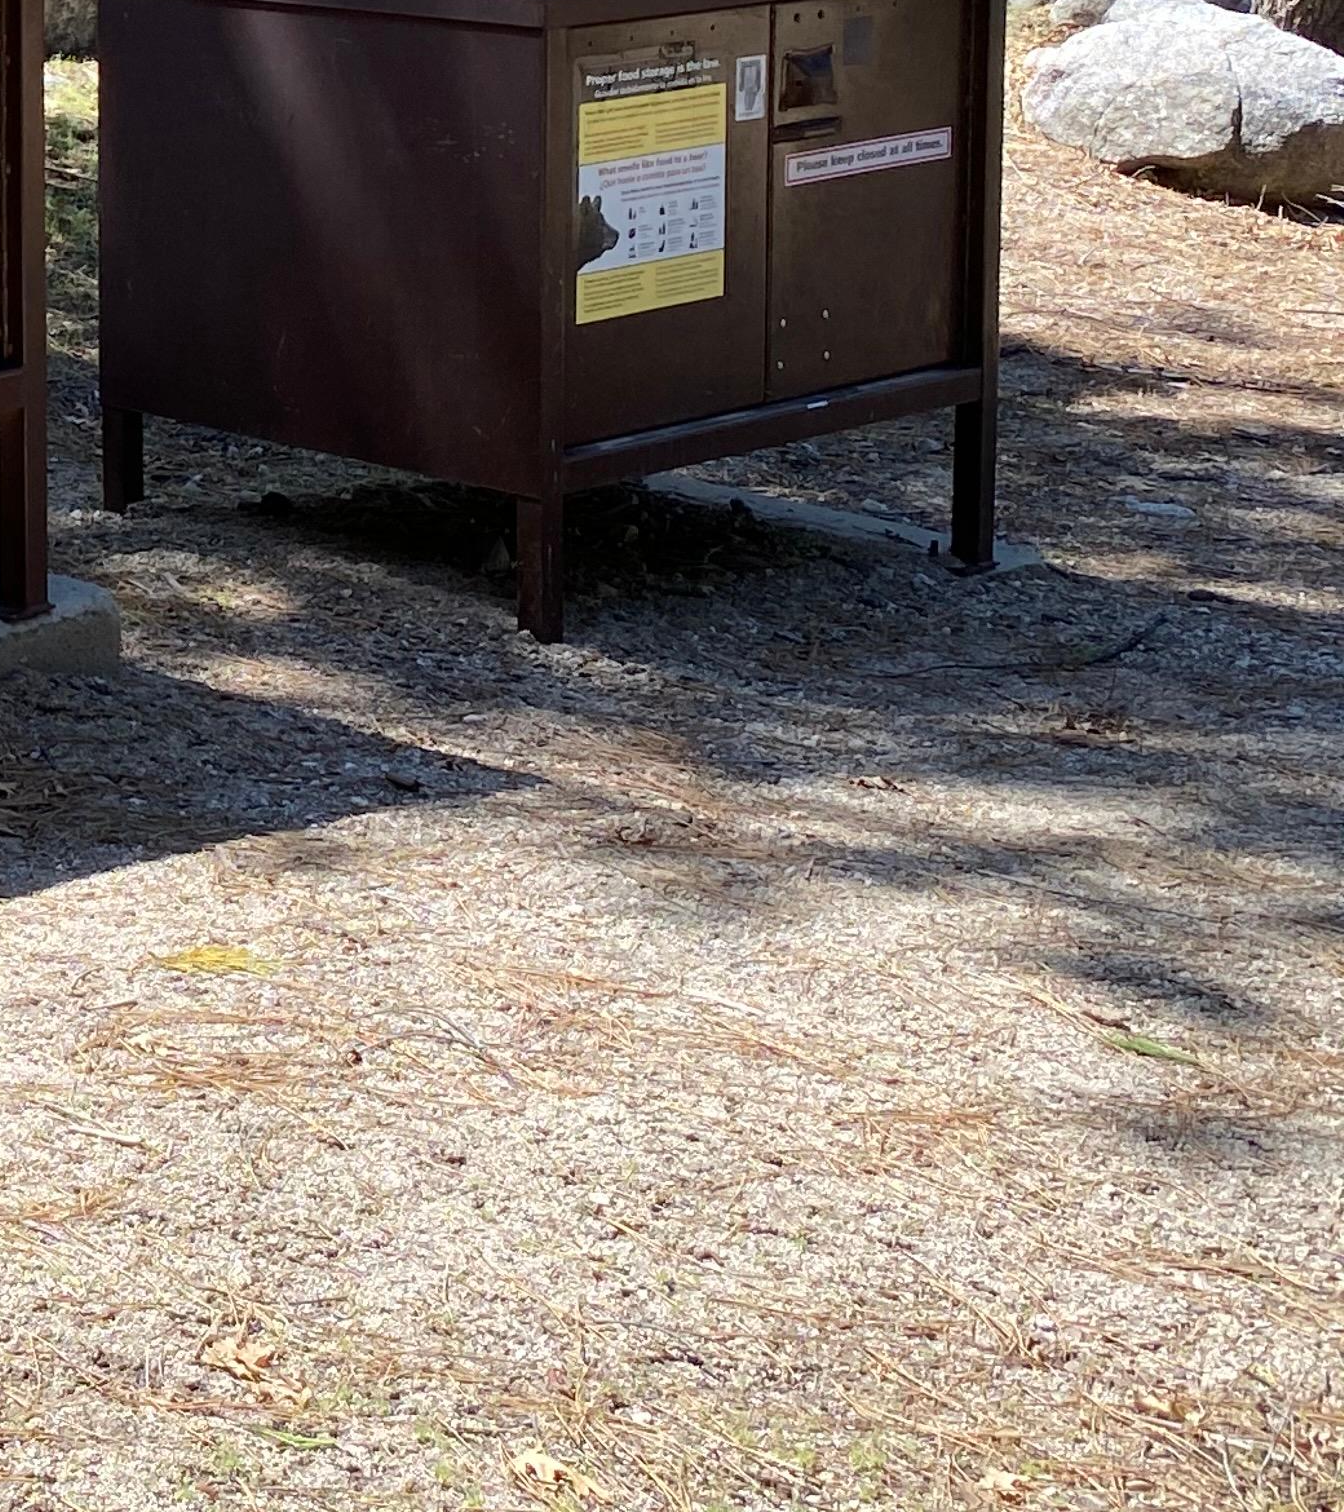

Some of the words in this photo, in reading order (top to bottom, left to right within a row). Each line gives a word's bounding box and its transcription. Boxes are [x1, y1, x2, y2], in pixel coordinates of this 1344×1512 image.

[796, 159, 828, 172] Please
[830, 154, 855, 166] keep
[857, 146, 887, 161] closed
[889, 144, 899, 155] at
[901, 140, 913, 154] all
[915, 139, 944, 151] times.
